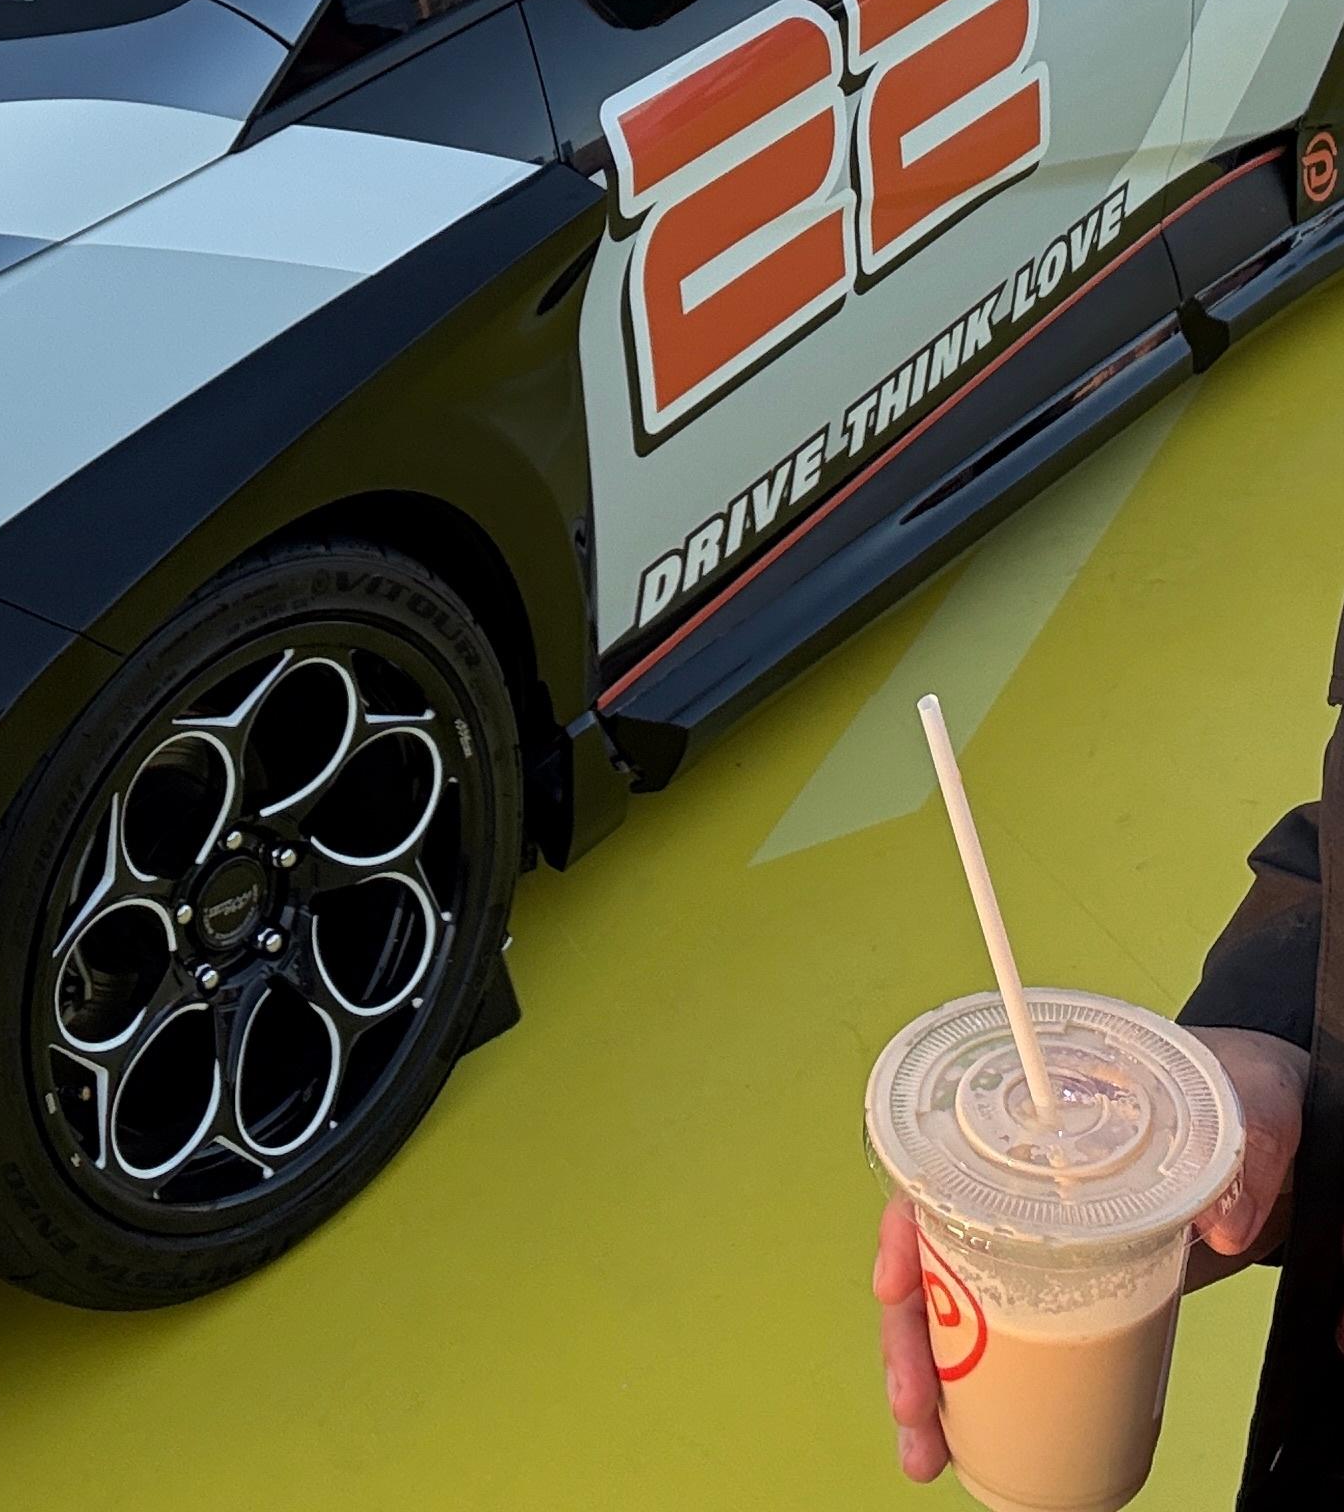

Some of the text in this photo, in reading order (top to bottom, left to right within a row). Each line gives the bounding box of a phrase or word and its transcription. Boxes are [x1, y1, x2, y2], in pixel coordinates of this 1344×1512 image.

[639, 184, 1127, 629] DRIVE THINK LOVE
